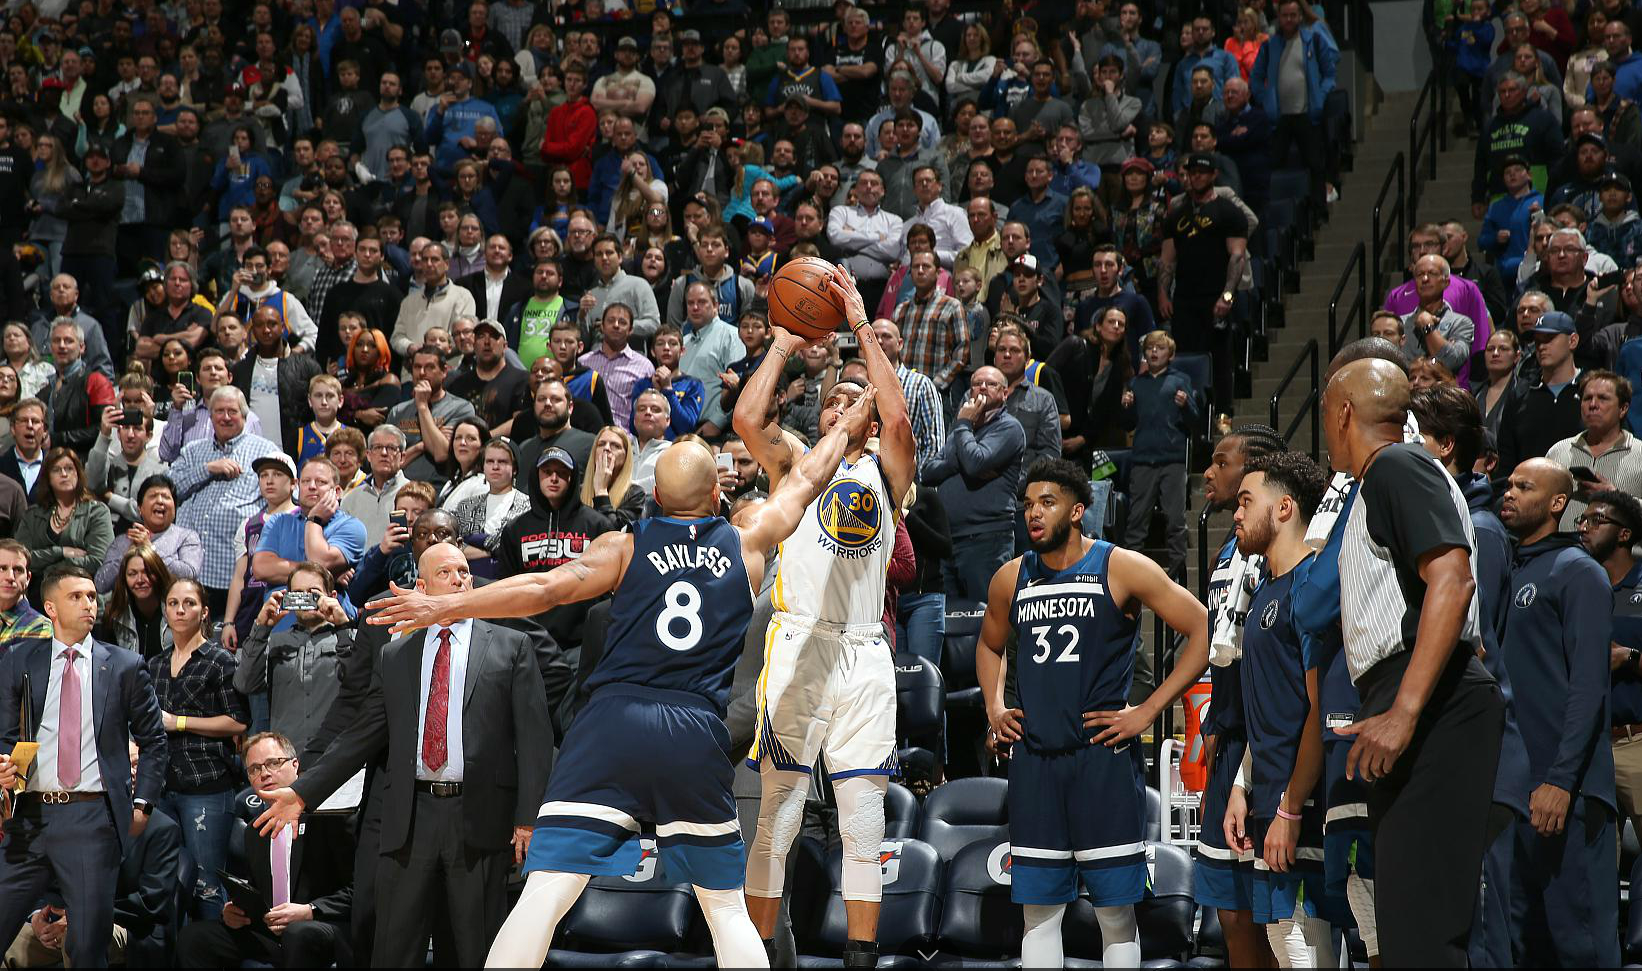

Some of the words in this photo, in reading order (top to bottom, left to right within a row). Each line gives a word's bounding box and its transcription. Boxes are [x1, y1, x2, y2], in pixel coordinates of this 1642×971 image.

[783, 83, 814, 97] TOWN
[525, 317, 551, 337] 32
[848, 492, 874, 512] 30
[521, 531, 590, 543] FOOTBALL
[817, 533, 882, 560] WARRIORS
[521, 538, 591, 562] FBU
[646, 543, 732, 578] BAYLESS
[1081, 574, 1098, 583] fitbit
[656, 580, 703, 651] 8
[944, 610, 986, 618] LEXUS
[1017, 597, 1095, 624] MINNESOTA
[1031, 624, 1080, 664] 32
[895, 664, 923, 673] XUS
